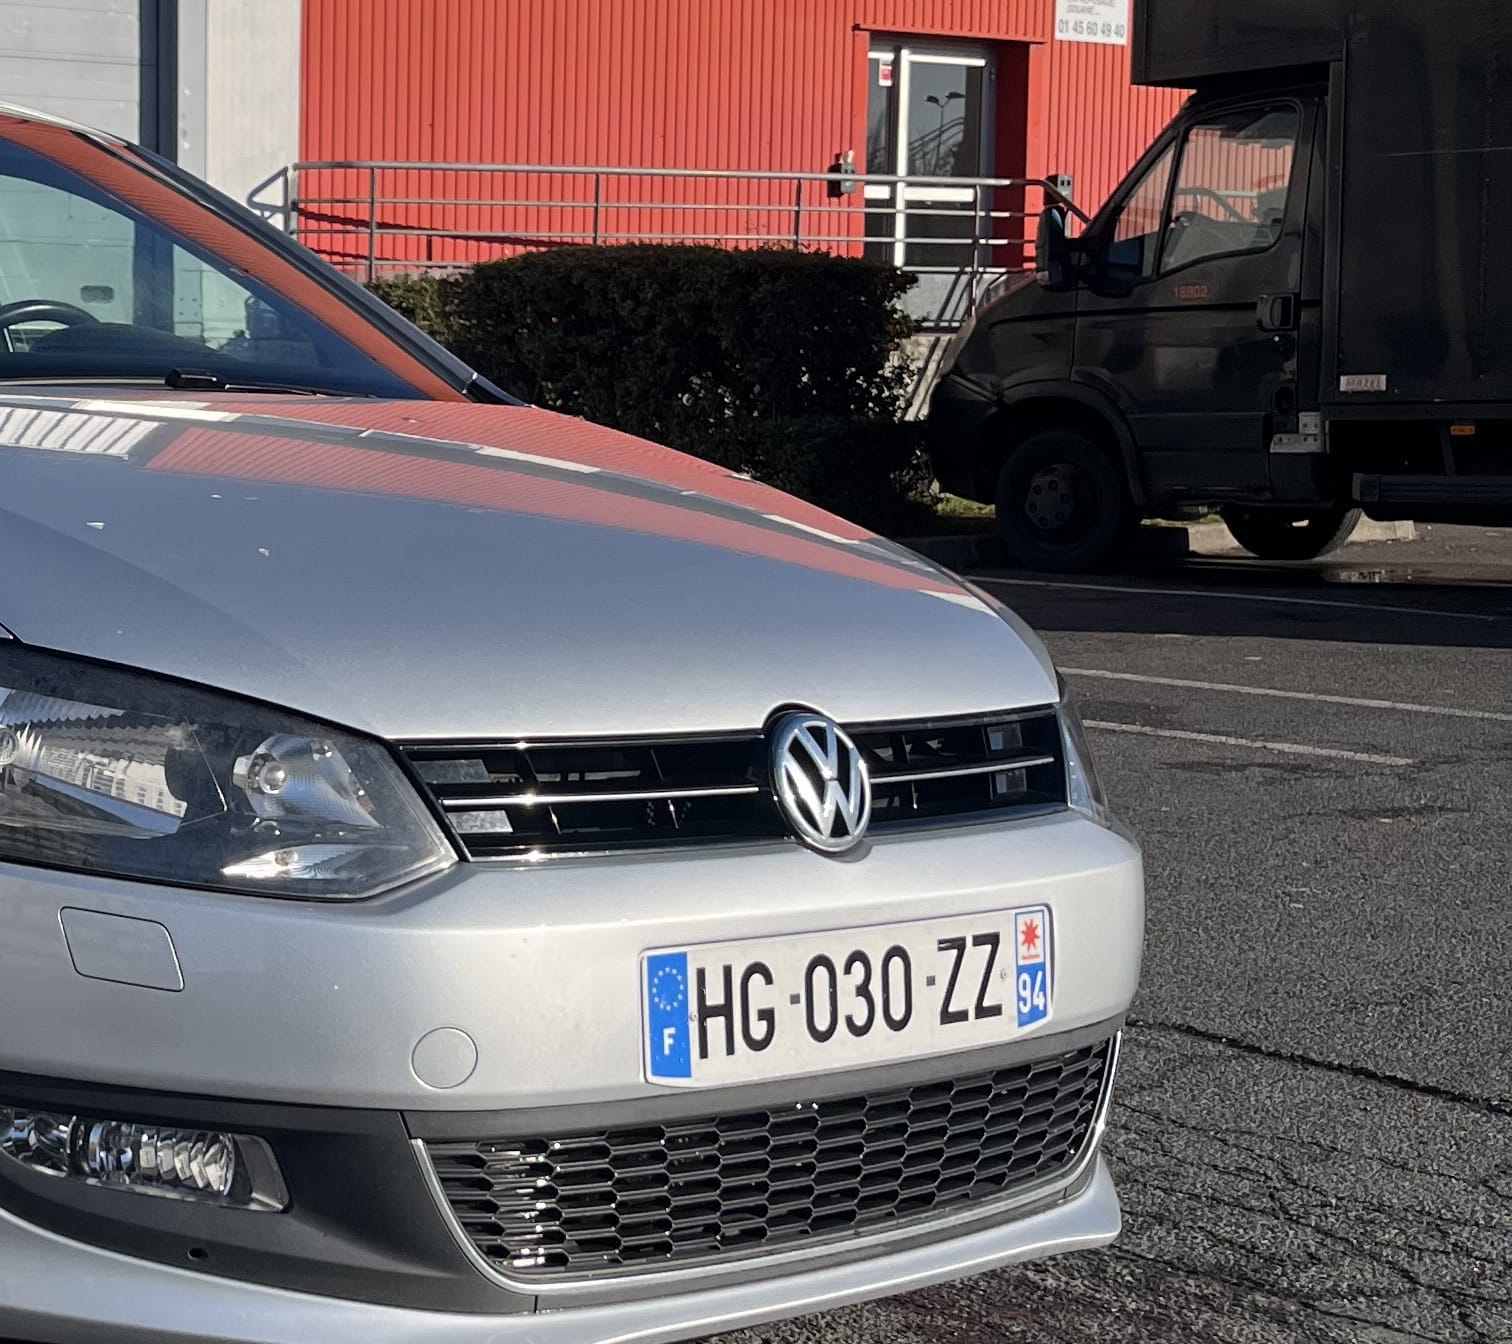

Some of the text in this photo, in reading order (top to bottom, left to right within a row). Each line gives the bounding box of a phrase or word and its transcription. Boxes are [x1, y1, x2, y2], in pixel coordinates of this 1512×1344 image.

[1058, 19, 1125, 38] 01 45 60 49 40
[661, 1027, 677, 1055] F
[1017, 970, 1046, 1014] 94
